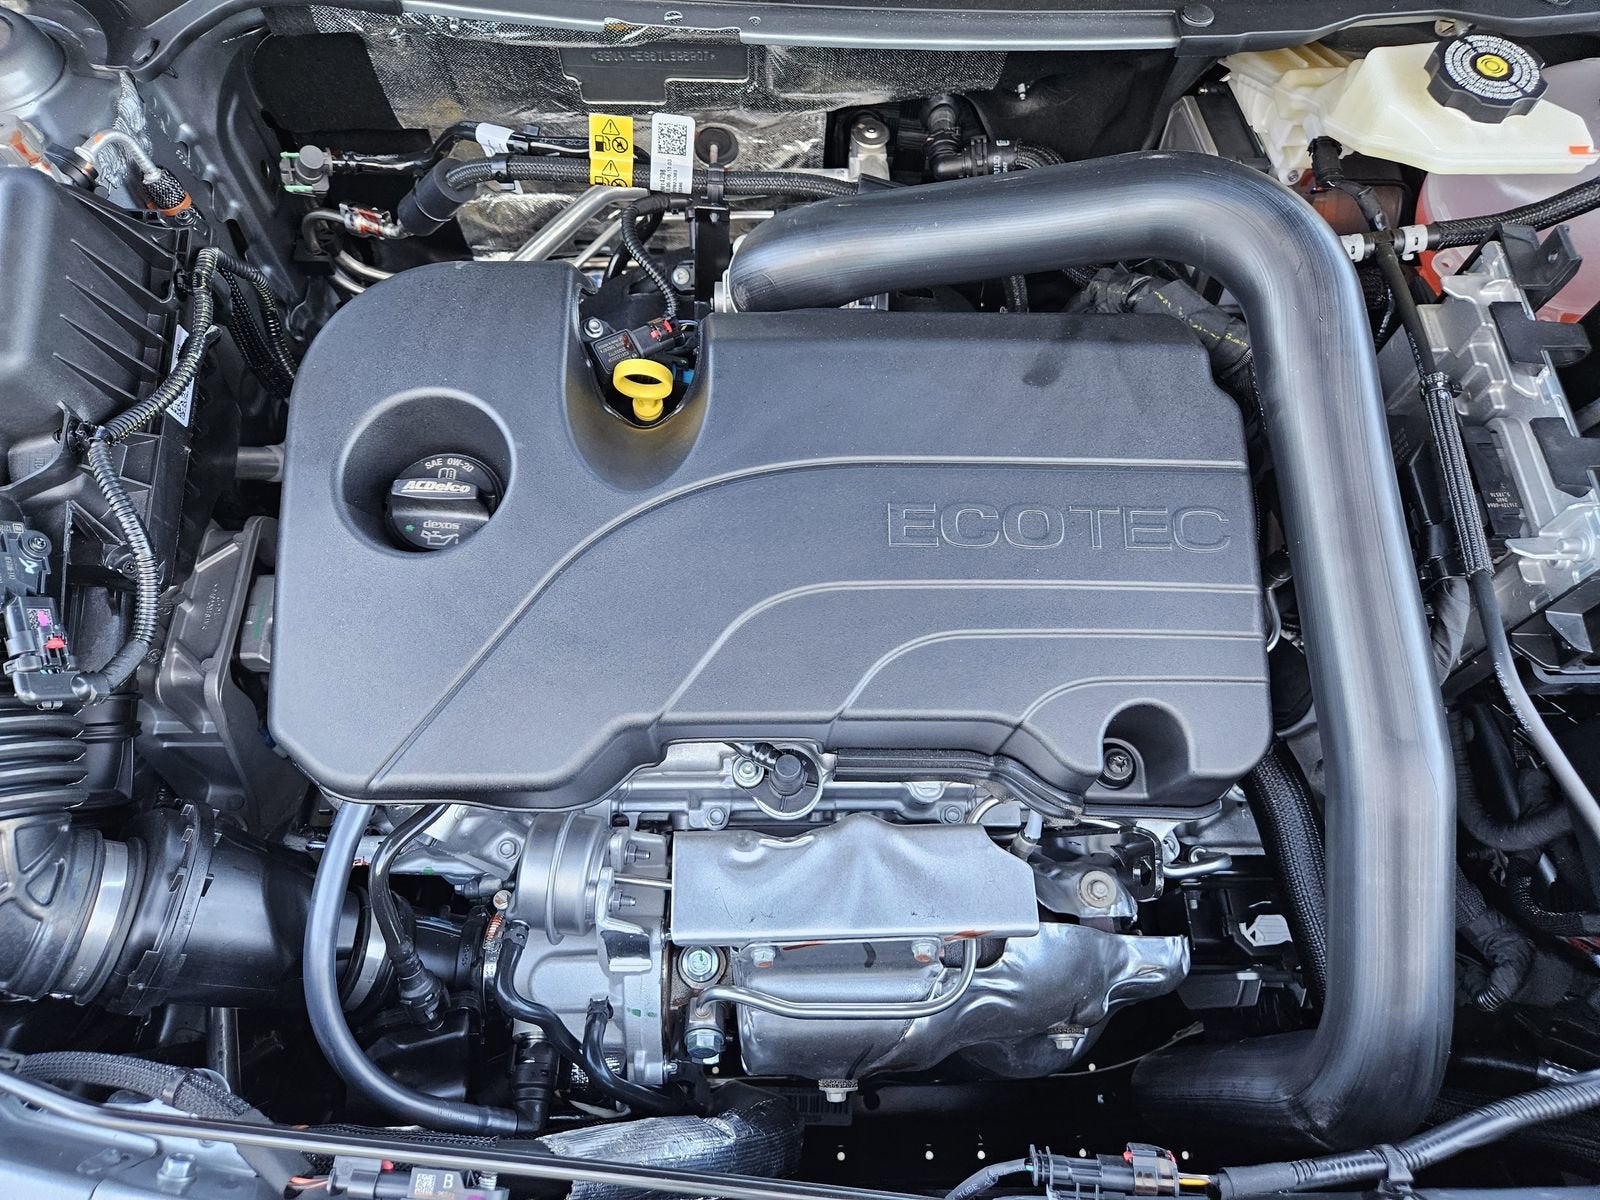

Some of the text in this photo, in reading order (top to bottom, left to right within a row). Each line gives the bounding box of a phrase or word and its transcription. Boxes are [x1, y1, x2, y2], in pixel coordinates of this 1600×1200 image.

[424, 457, 474, 473] SAE 0W-20
[401, 480, 471, 494] ACDelco
[423, 519, 461, 530] dexos
[886, 500, 1232, 552] ECOTEC
[442, 1173, 455, 1189] B
[957, 1183, 980, 1199] TUBE
